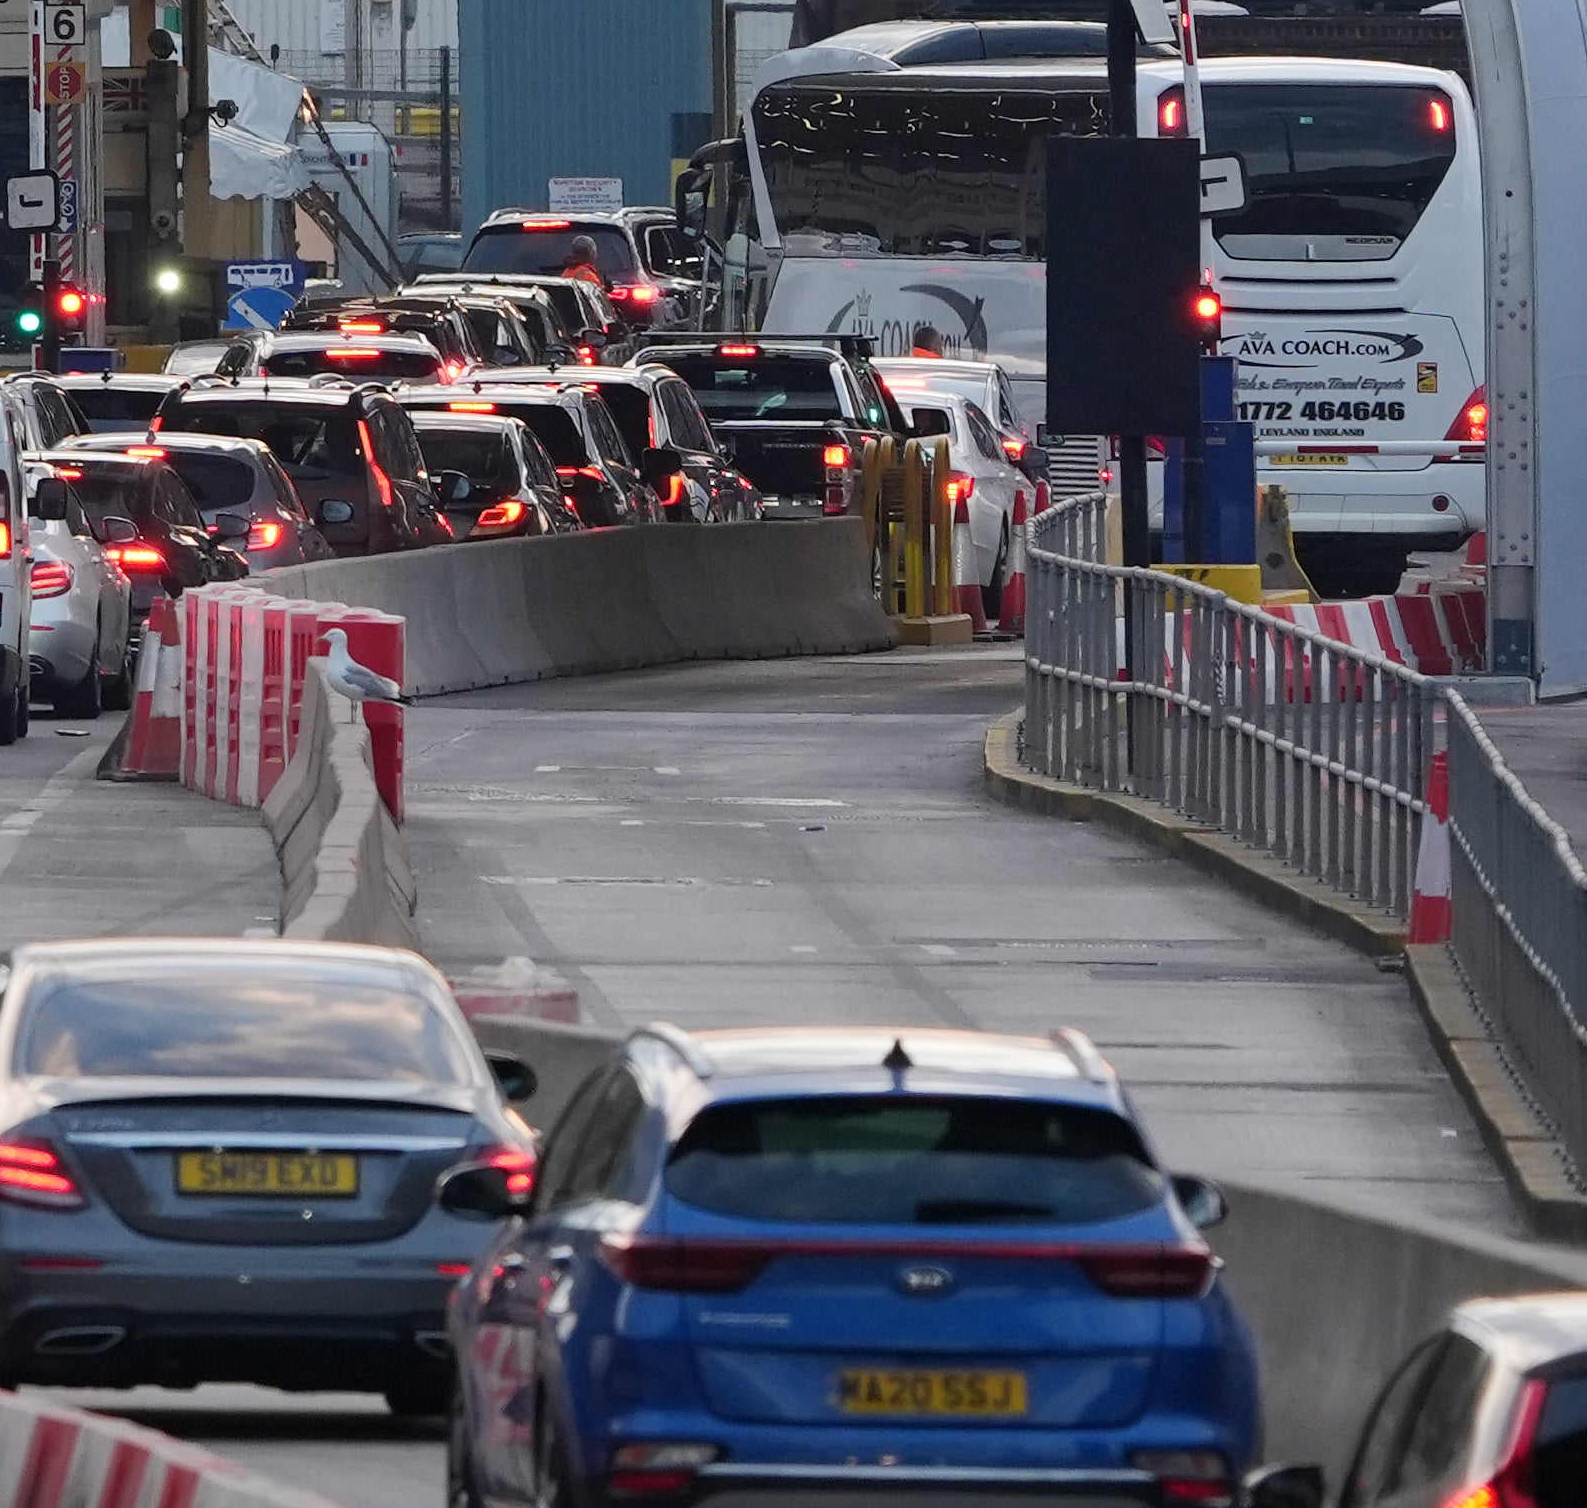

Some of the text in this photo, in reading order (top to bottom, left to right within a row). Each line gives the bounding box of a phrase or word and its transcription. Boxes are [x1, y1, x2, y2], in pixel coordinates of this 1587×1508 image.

[53, 8, 76, 41] 6
[58, 65, 72, 100] STOP
[1238, 339, 1276, 356] AVA
[1328, 375, 1363, 390] Travel
[1237, 401, 1406, 422] 1772 464646
[1259, 428, 1365, 437] LEYLAND ENGLAND
